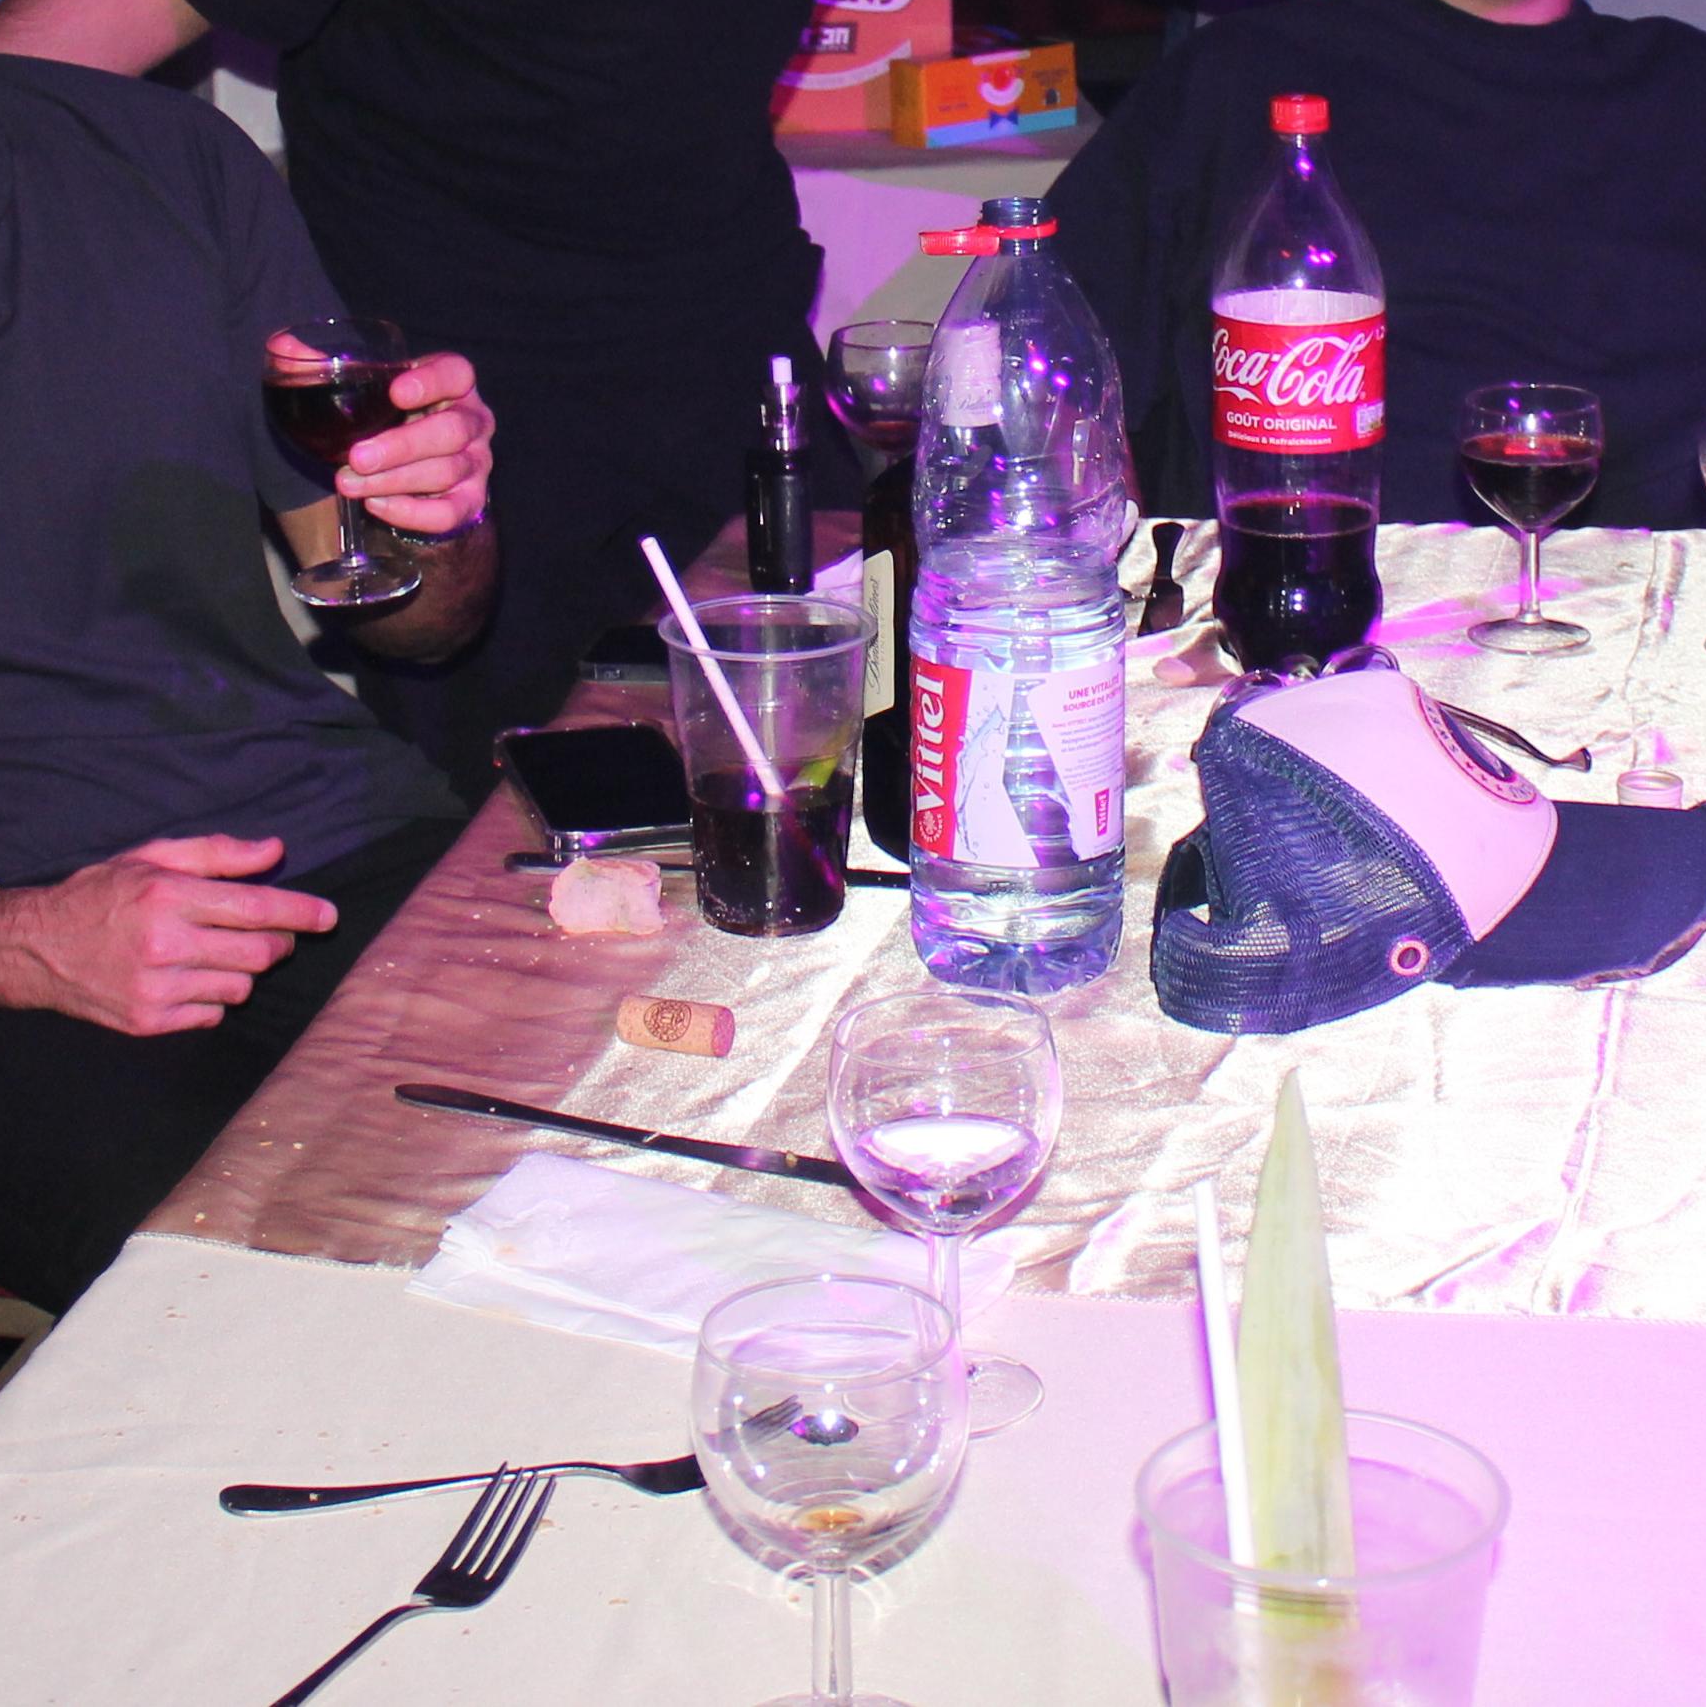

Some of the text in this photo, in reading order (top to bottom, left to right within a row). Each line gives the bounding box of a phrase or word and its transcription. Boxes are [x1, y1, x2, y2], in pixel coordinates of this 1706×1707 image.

[1211, 327, 1375, 407] Coca-Cola
[1226, 409, 1338, 432] GOÛT ORIGINAL
[1068, 686, 1089, 701] UNE
[915, 672, 946, 813] Vittel
